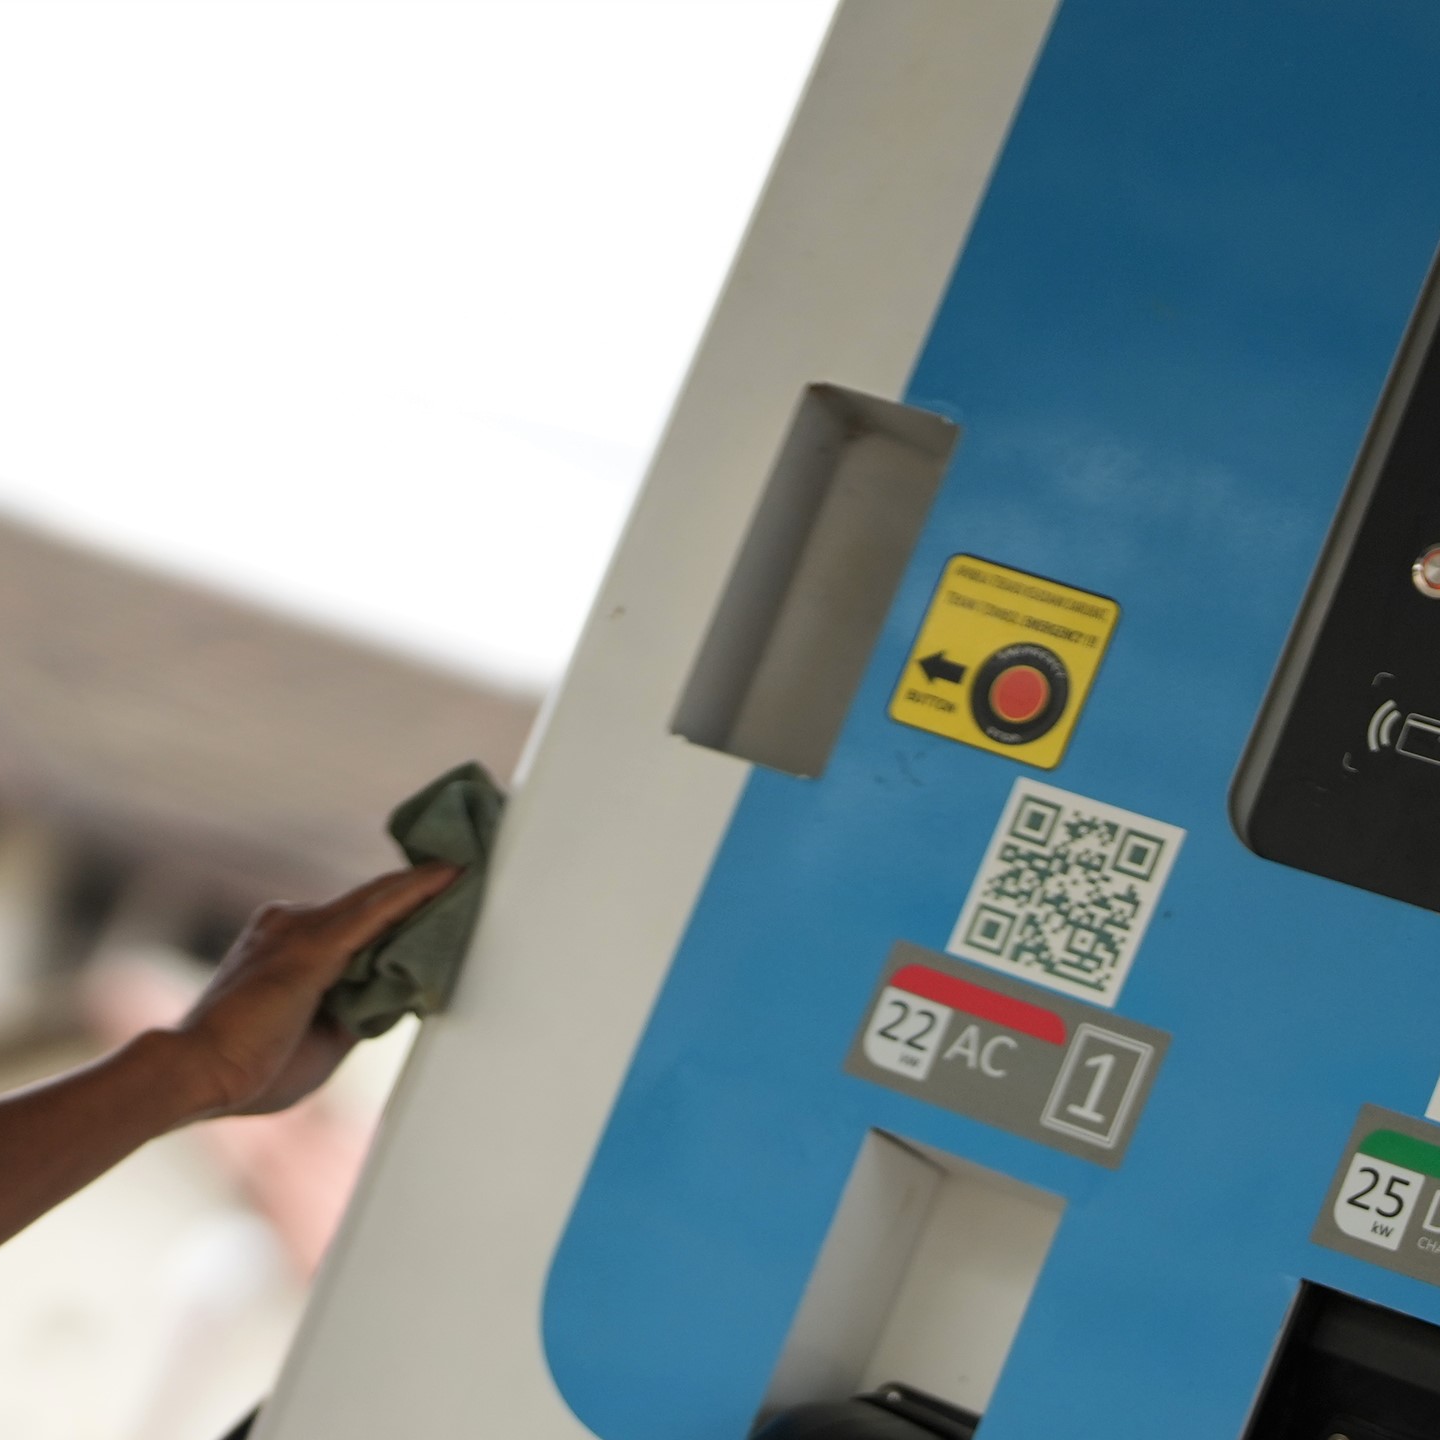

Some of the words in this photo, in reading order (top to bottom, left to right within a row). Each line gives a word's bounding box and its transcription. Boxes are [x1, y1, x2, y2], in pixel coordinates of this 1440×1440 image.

[878, 999, 937, 1052] 22
[942, 1023, 1019, 1079] AC
[1065, 1053, 1116, 1125] 1
[1346, 1166, 1411, 1219] 25
[1370, 1220, 1396, 1239] kW
